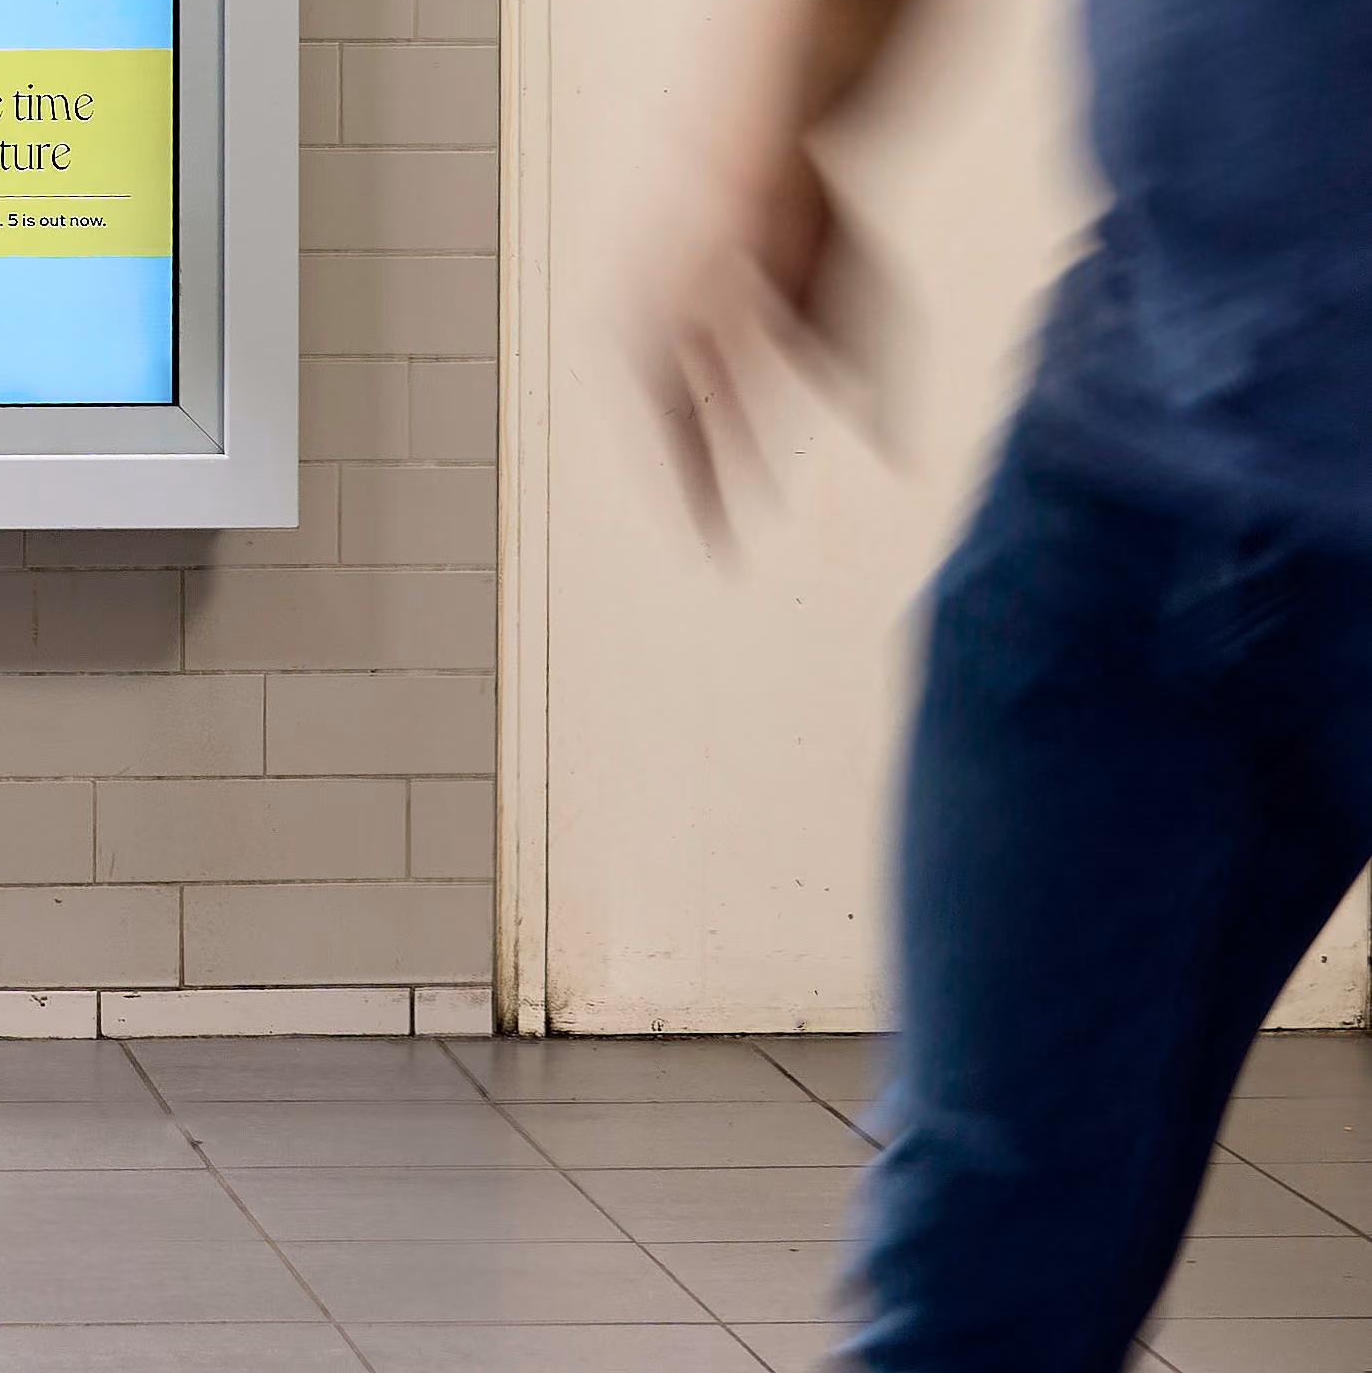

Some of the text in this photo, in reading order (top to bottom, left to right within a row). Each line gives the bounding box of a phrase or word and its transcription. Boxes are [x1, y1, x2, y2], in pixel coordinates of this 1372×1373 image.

[13, 83, 95, 122] time
[8, 213, 20, 228] 5
[21, 213, 36, 228] is
[39, 214, 67, 228] out
[70, 217, 107, 228] now.
